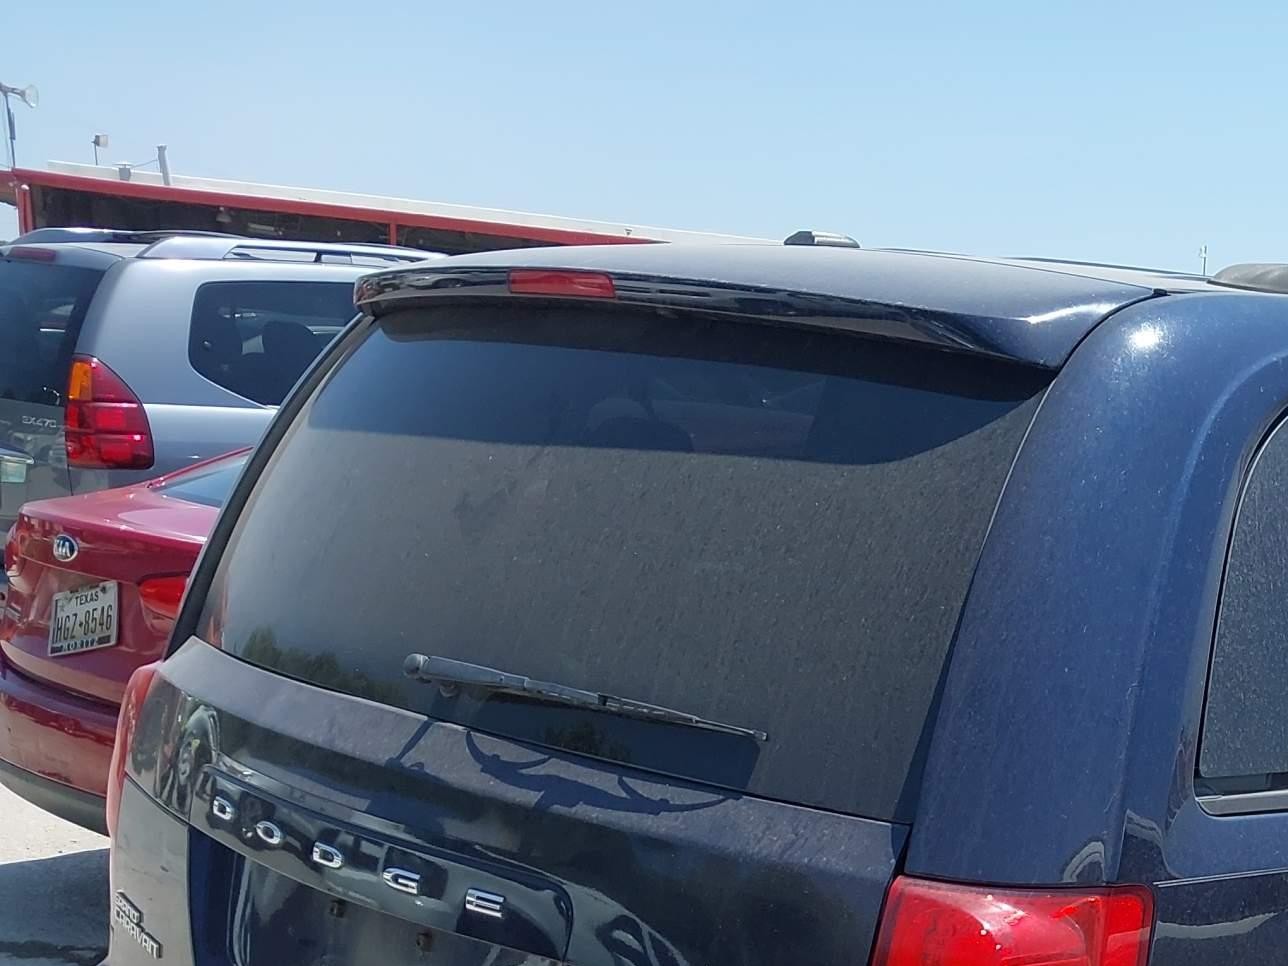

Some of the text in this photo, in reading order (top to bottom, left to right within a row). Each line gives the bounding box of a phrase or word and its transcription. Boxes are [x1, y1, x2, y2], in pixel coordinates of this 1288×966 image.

[74, 591, 99, 608] TEXAS
[212, 796, 504, 918] DODGE
[115, 906, 160, 959] CARAVAN
